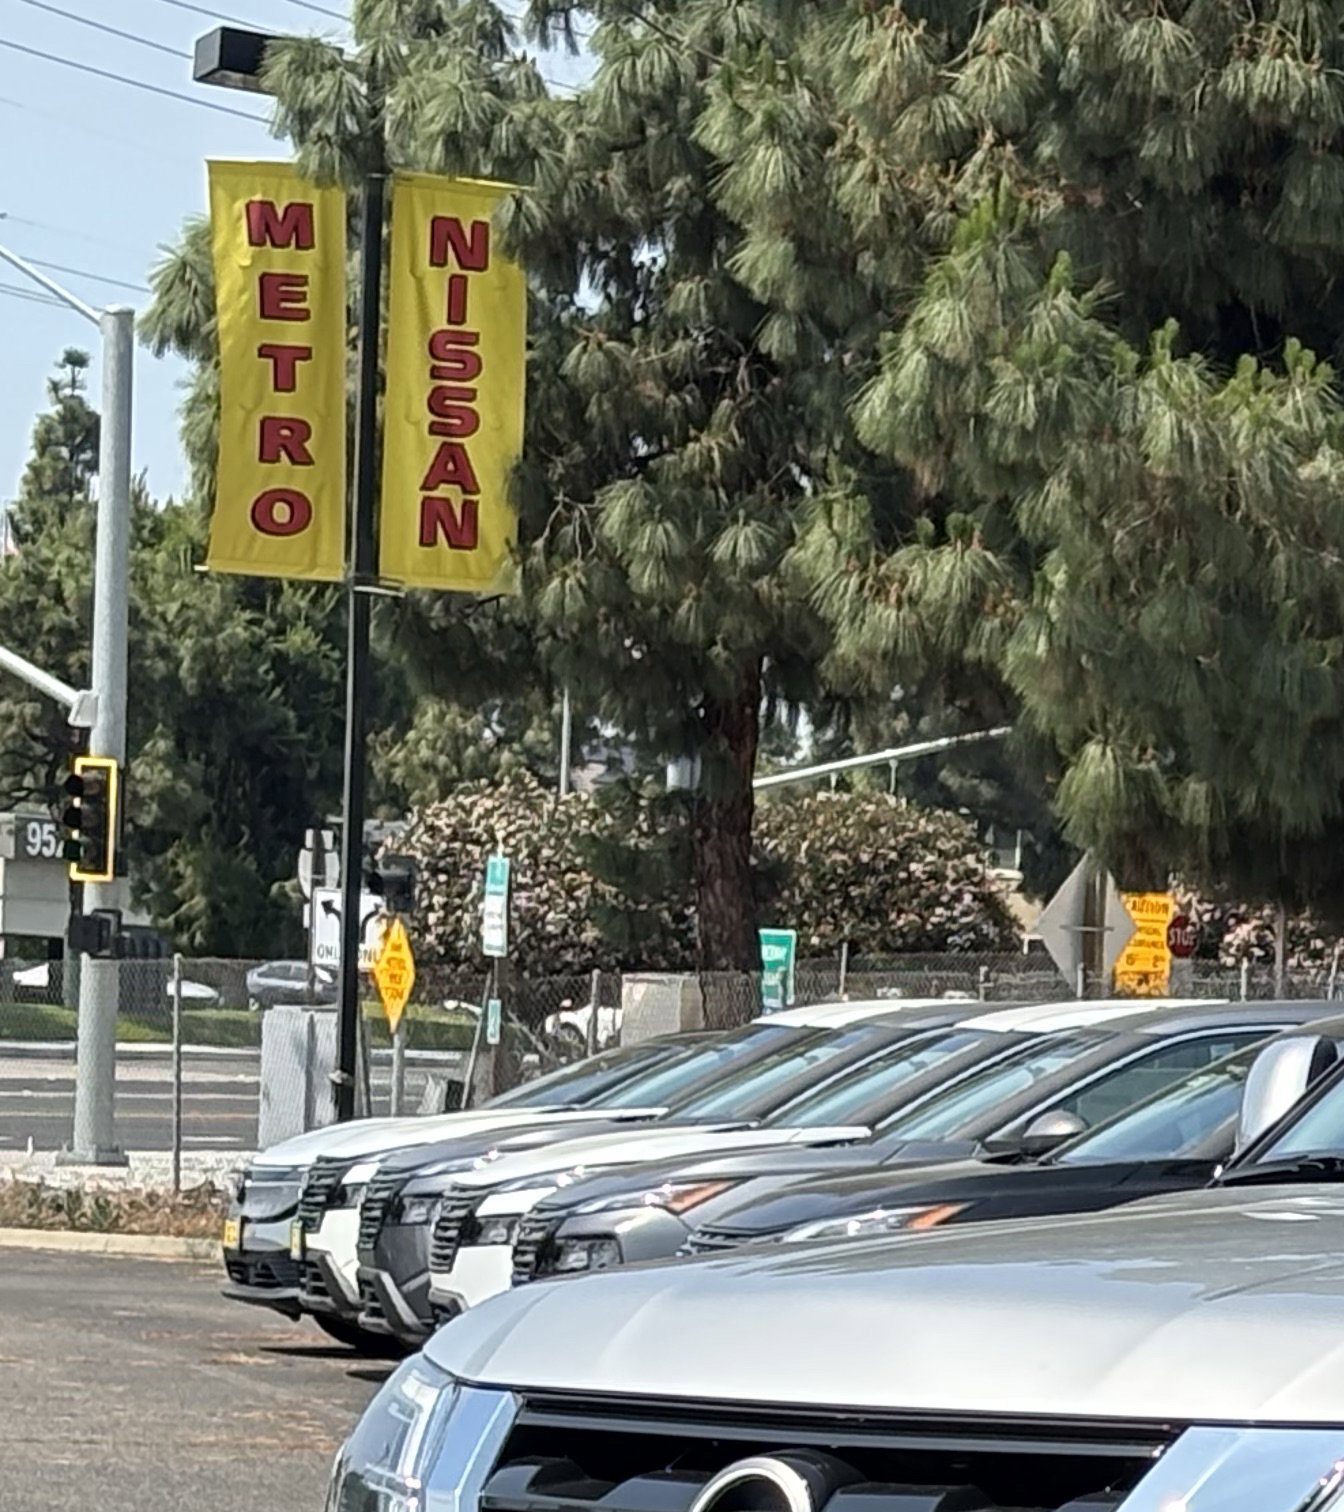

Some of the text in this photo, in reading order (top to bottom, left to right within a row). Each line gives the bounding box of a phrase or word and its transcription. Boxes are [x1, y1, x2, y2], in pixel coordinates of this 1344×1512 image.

[245, 199, 316, 538] METRO
[419, 215, 490, 551] NISSAN
[1168, 927, 1195, 946] STOP
